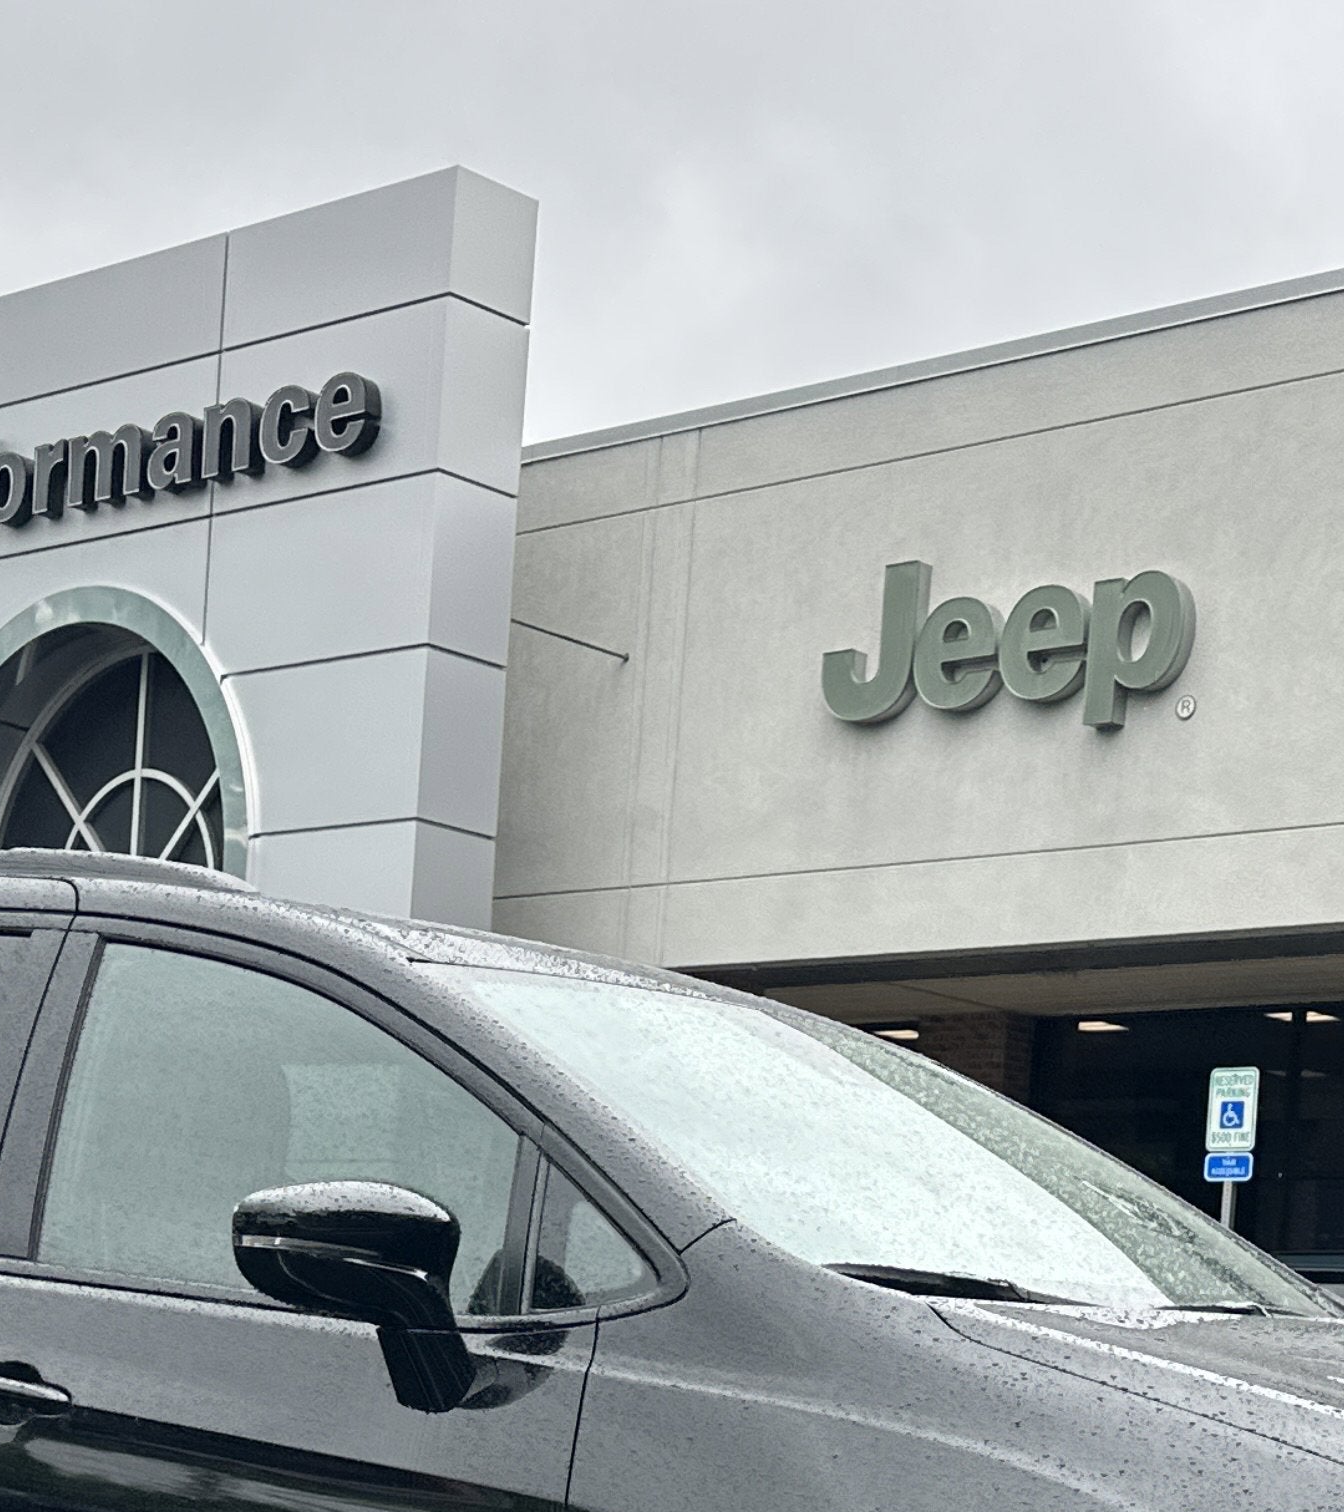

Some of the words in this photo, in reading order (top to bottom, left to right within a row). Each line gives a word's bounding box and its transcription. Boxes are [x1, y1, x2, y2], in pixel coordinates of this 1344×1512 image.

[821, 559, 1197, 732] Jeep
[1215, 1074, 1254, 1087] RESERVED
[1216, 1087, 1251, 1098] PARKING
